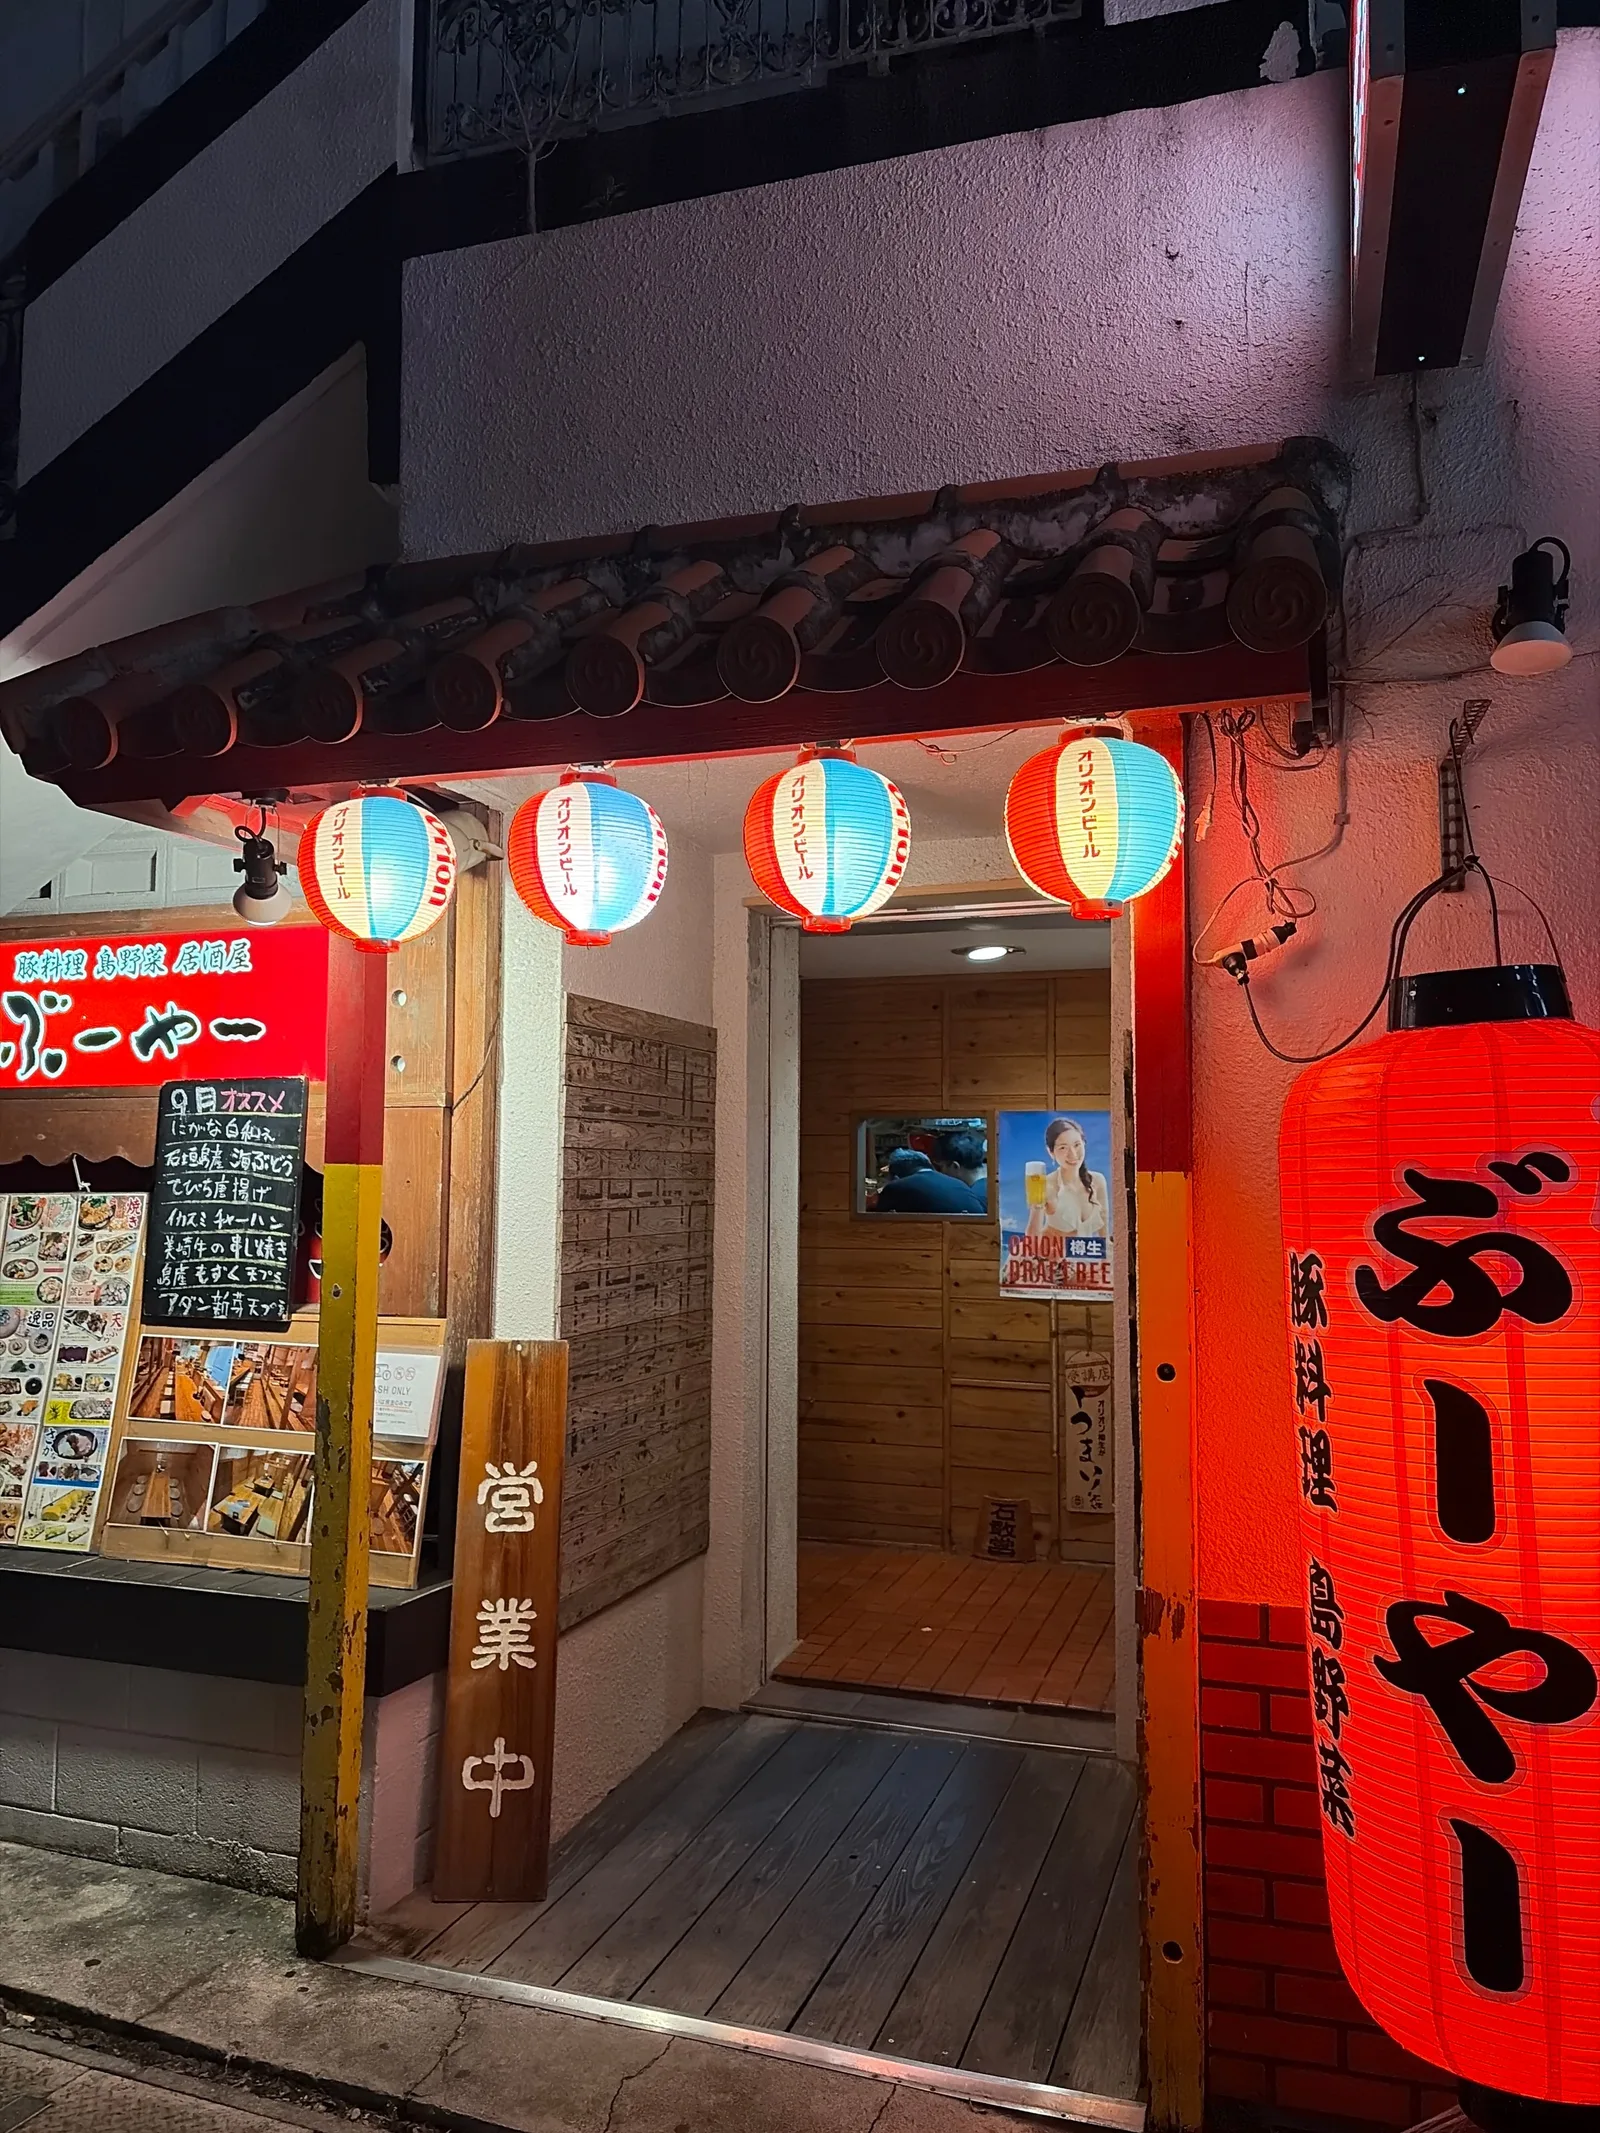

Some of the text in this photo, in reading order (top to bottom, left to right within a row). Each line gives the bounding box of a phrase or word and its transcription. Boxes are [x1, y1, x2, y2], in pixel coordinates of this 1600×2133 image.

[556, 796, 578, 896] オリオンビール
[789, 774, 814, 881] オリオンビール
[1077, 750, 1100, 858] オリオンビール
[332, 807, 351, 900] オリオンビール
[425, 815, 456, 906] Orion
[15, 940, 252, 982] 豚料理 島野菜 居酒屋
[0, 992, 265, 1078] ぶーやー
[172, 1117, 276, 1141] にがな白和え
[1008, 1235, 1064, 1258] ORION
[1076, 1262, 1111, 1284] BEE
[392, 1386, 411, 1395] ONLY
[1354, 1150, 1598, 1993] ぶーやー
[462, 1460, 544, 1819] 営業中
